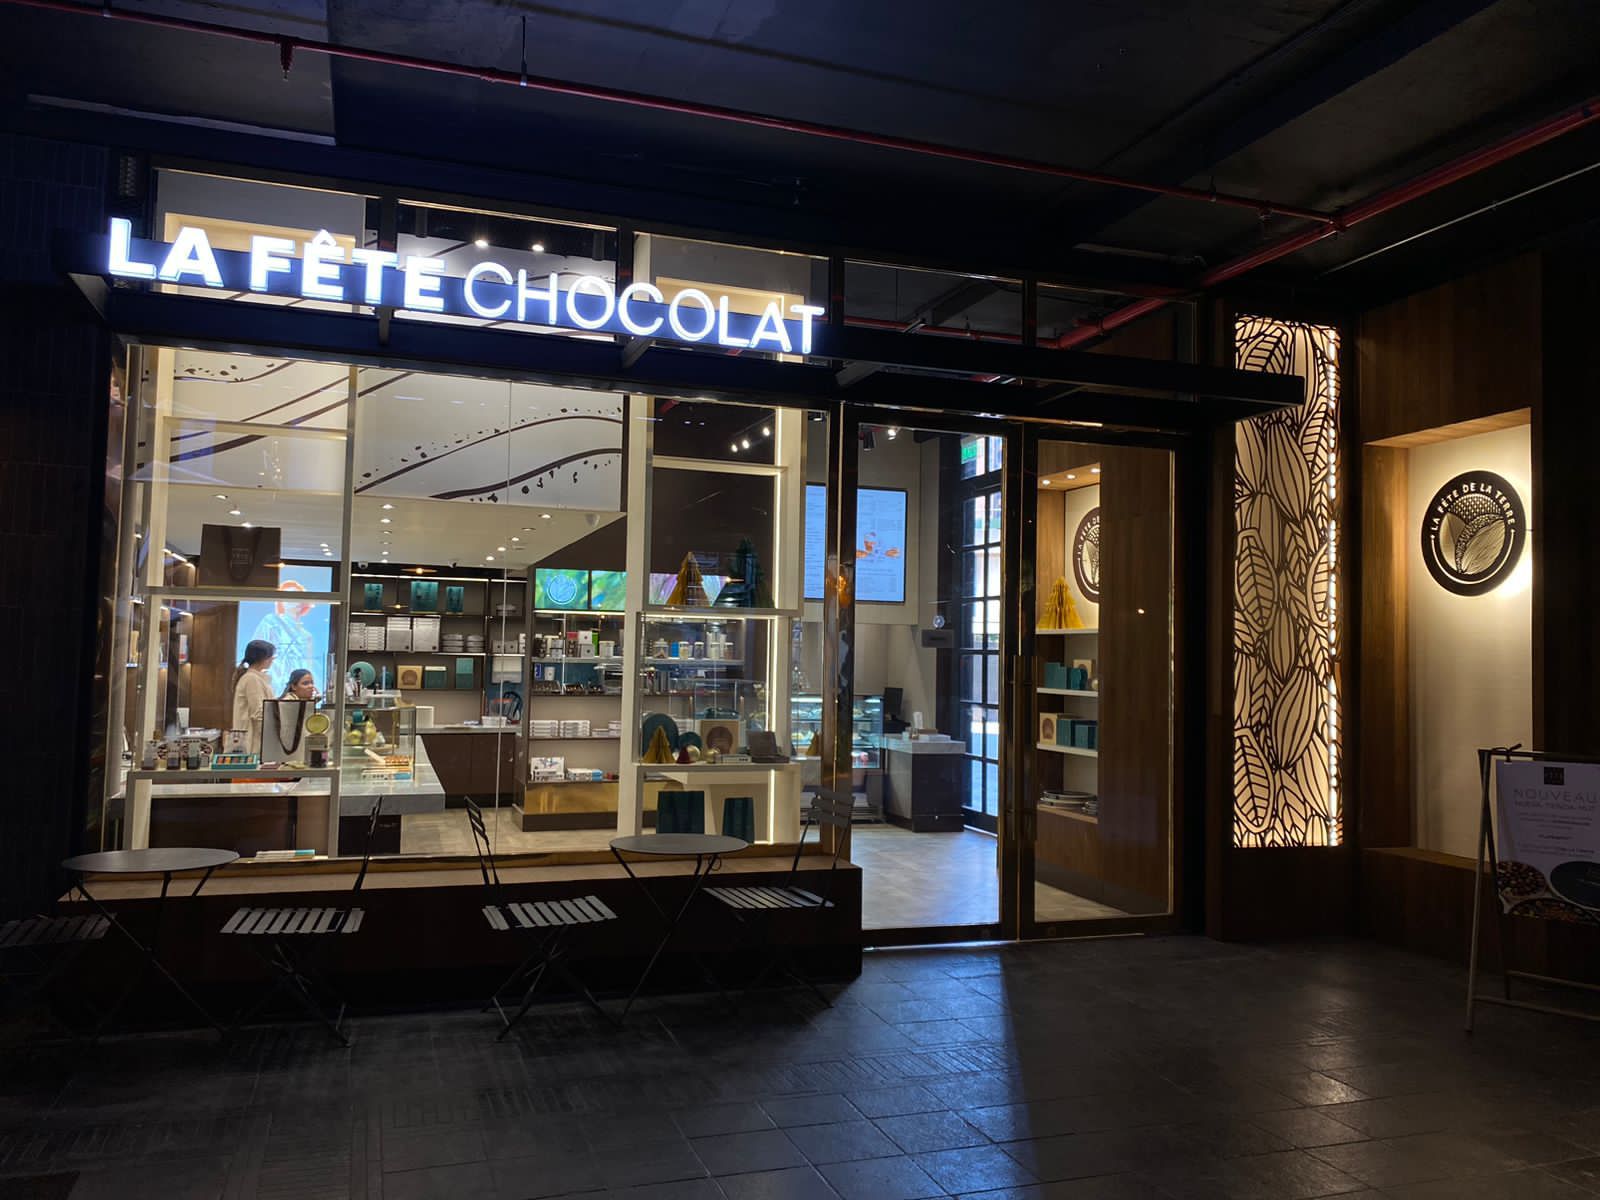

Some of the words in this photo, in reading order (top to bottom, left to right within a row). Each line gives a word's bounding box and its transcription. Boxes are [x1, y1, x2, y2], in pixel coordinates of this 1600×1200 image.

[107, 217, 224, 288] LA
[249, 228, 444, 312] FÊTE
[463, 261, 824, 354] CHOCOLAT
[1431, 517, 1441, 531] LA
[1462, 482, 1477, 493] DE
[1479, 483, 1492, 494] LA
[1494, 490, 1516, 526] TERRE
